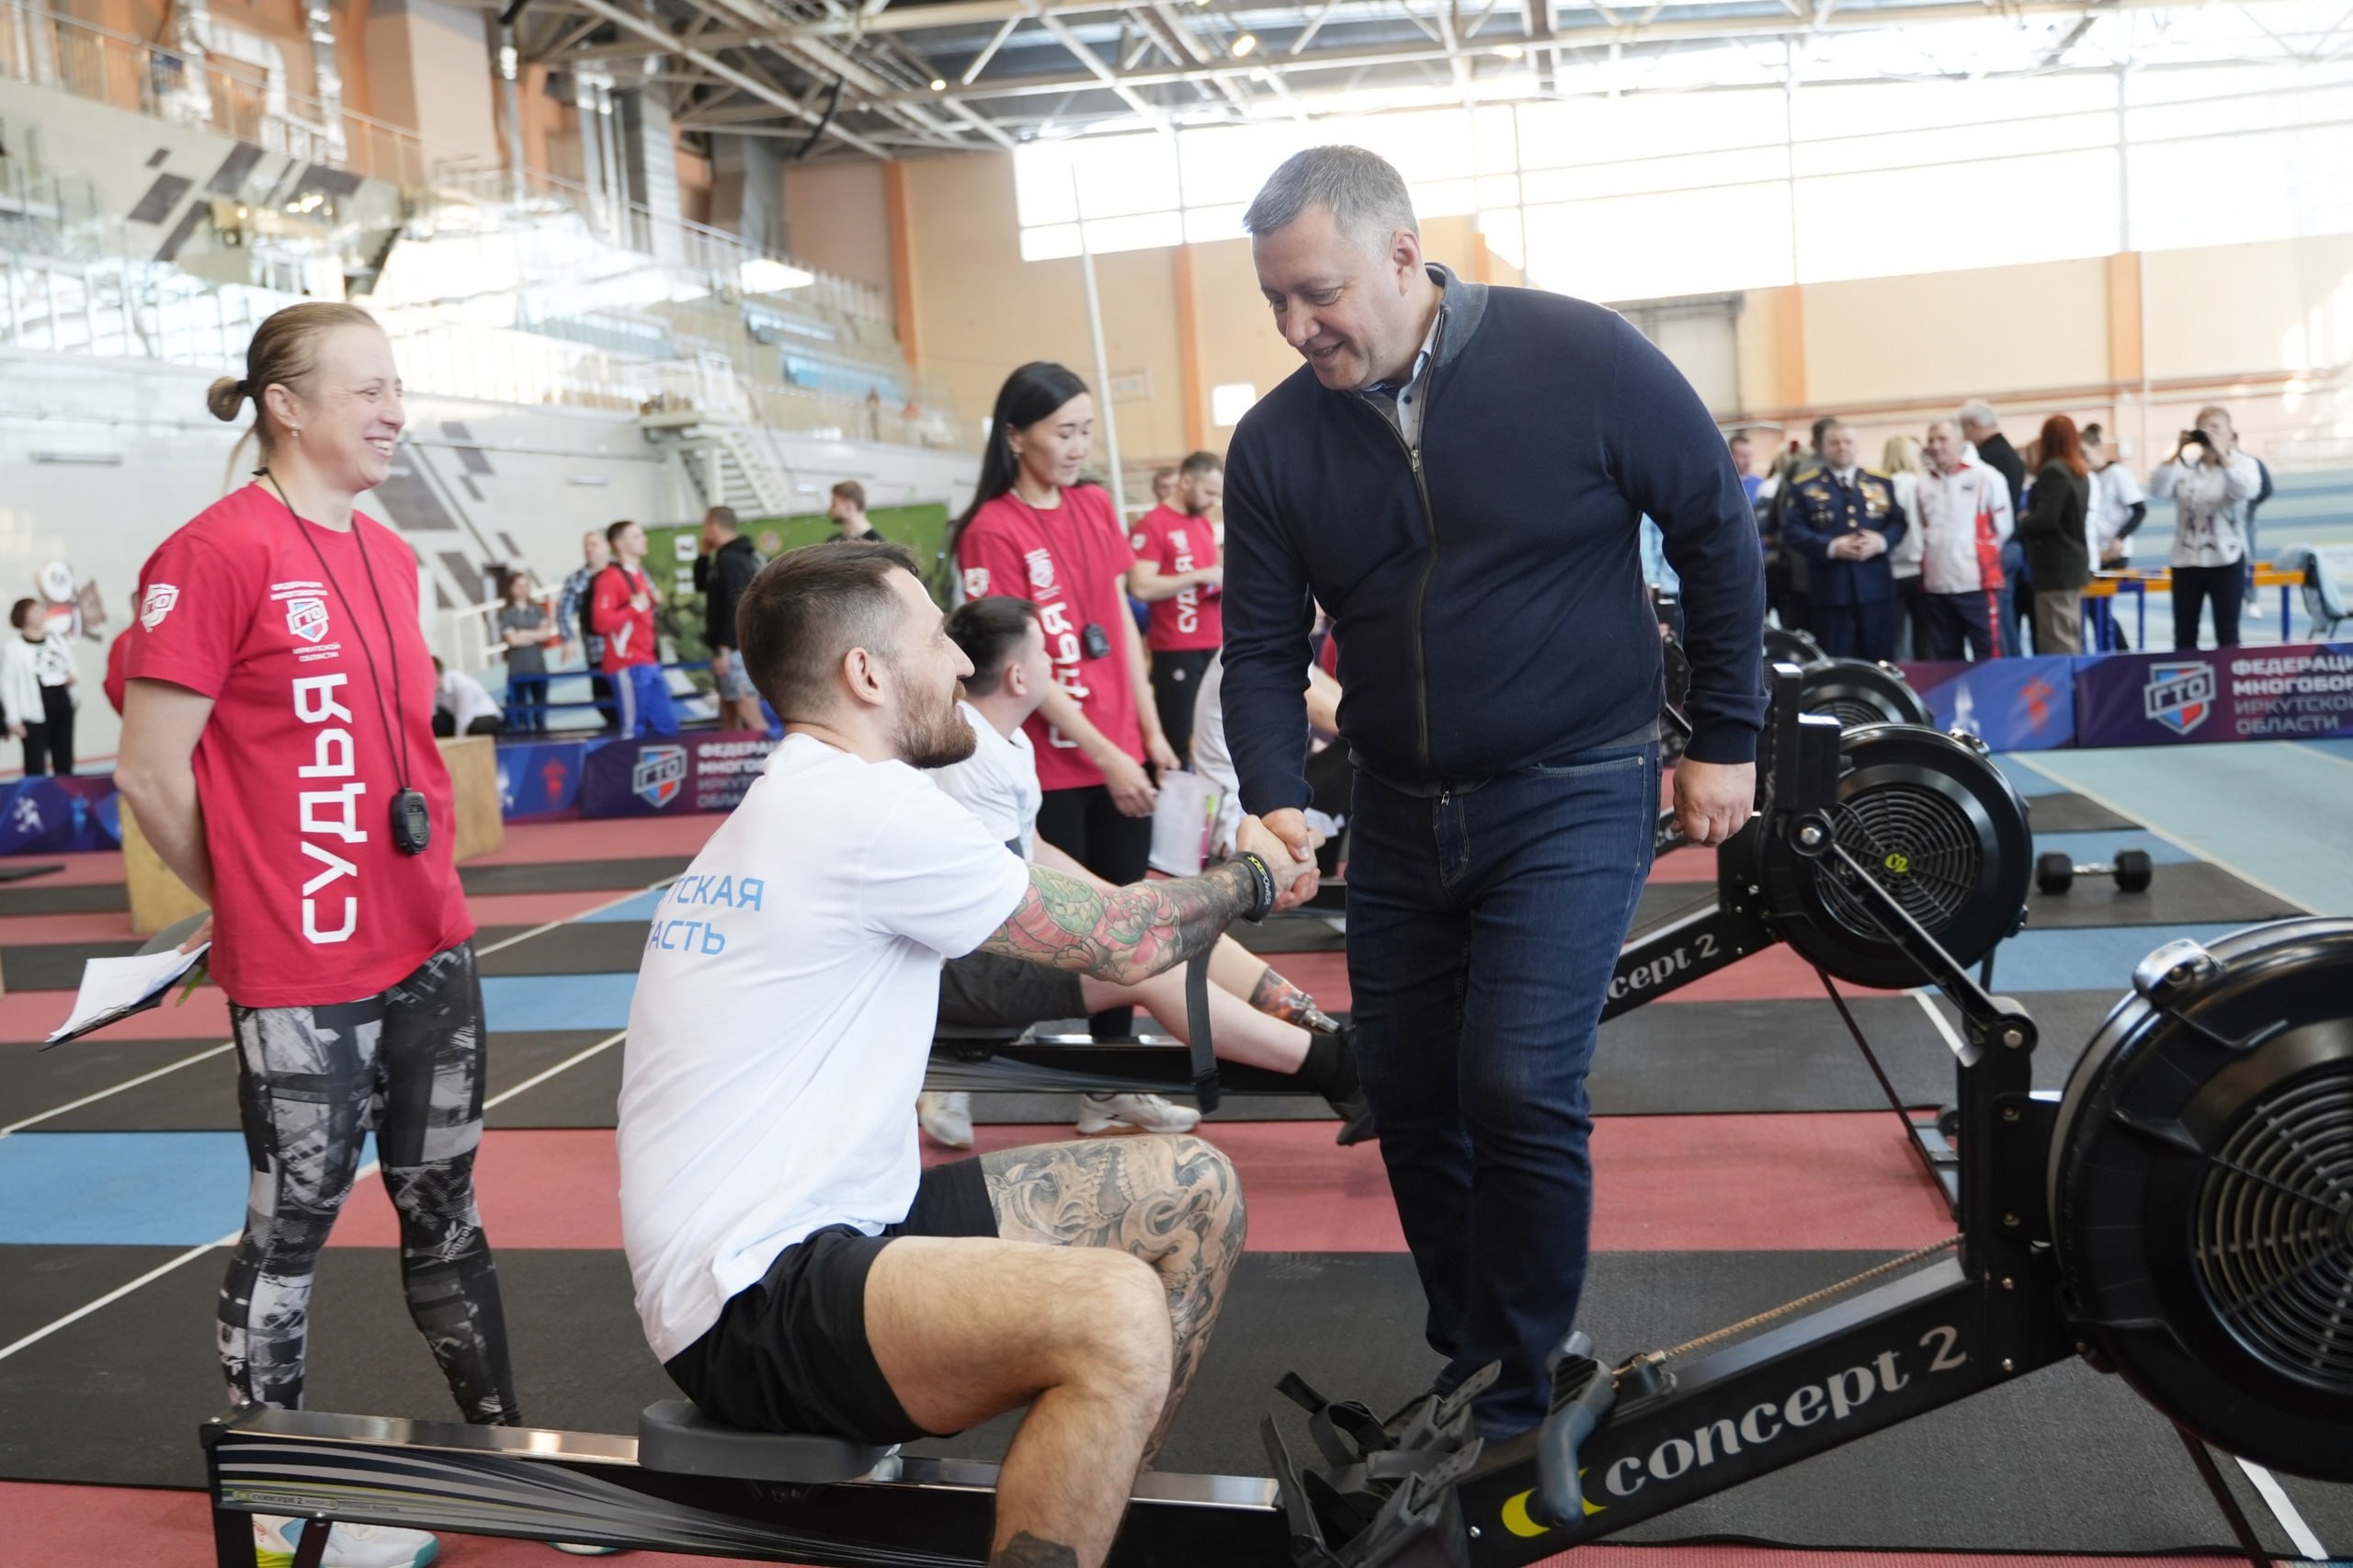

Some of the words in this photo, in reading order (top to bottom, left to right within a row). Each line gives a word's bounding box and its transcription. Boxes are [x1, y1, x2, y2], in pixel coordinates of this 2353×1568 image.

[1175, 555, 1199, 633] СУДЯ
[2154, 676, 2206, 709] ГТО
[2234, 695, 2353, 714] ИРКУТСКО
[2235, 714, 2339, 735] ОБЛАСТИ
[292, 672, 368, 944] СУДЬЯ
[1885, 853, 1908, 872] C2
[664, 875, 765, 912] ТСКАЯ
[647, 920, 726, 955] АСТЬ
[1605, 947, 1691, 1003] cept
[1694, 933, 1720, 959] 2
[1604, 1350, 1909, 1496] concept
[1918, 1324, 1967, 1373] 2
